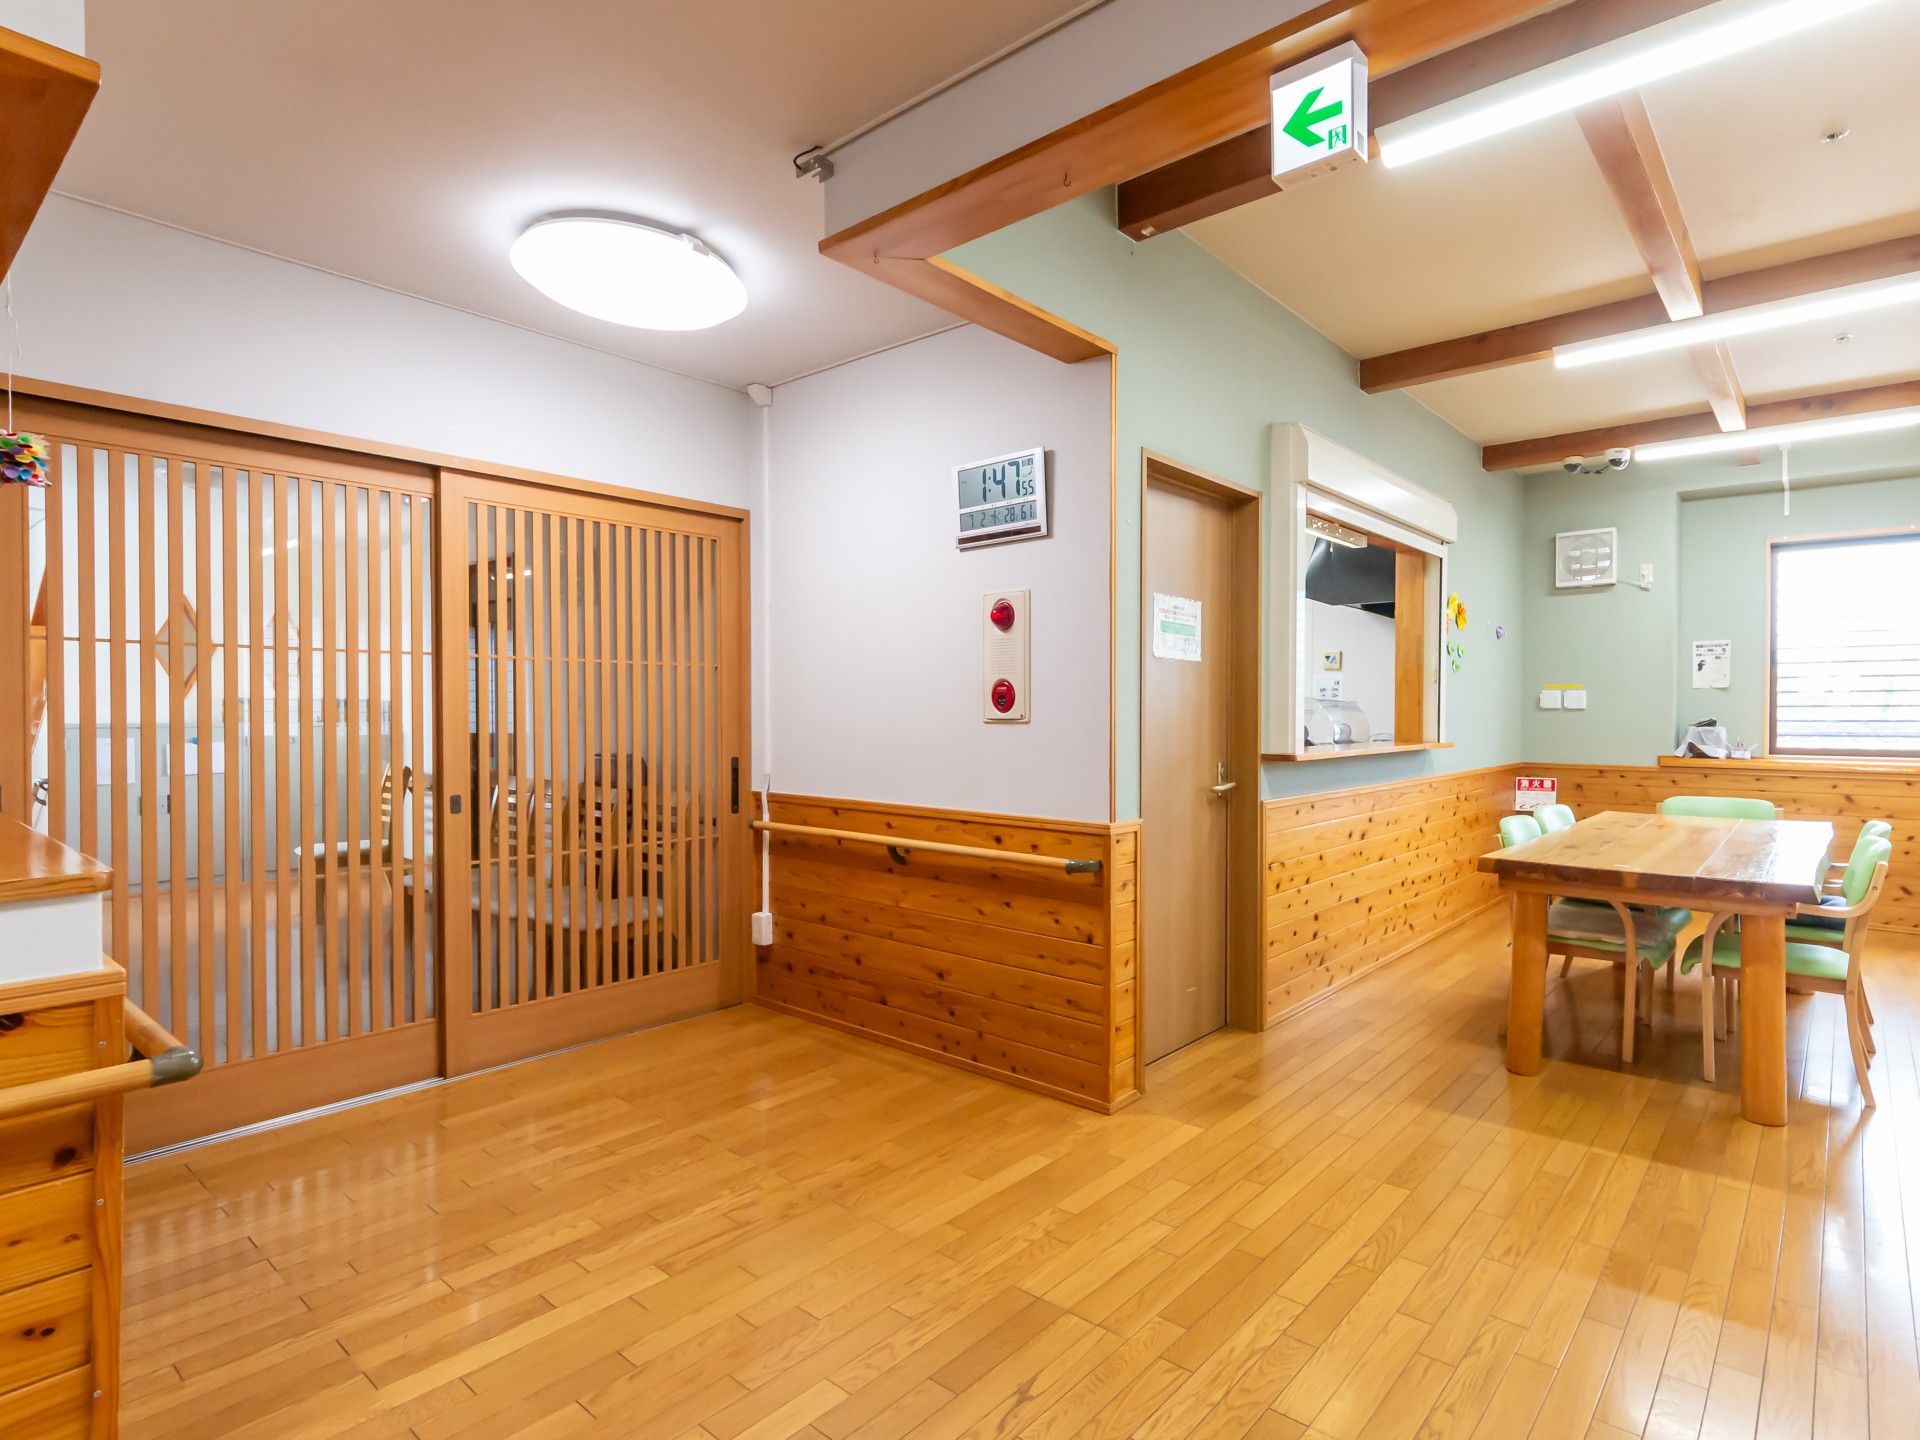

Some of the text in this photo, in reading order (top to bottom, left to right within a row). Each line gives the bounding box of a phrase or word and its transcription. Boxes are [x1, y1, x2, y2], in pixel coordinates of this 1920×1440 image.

[982, 460, 1020, 503] 1:47
[1021, 480, 1034, 496] 55
[980, 512, 986, 527] 2
